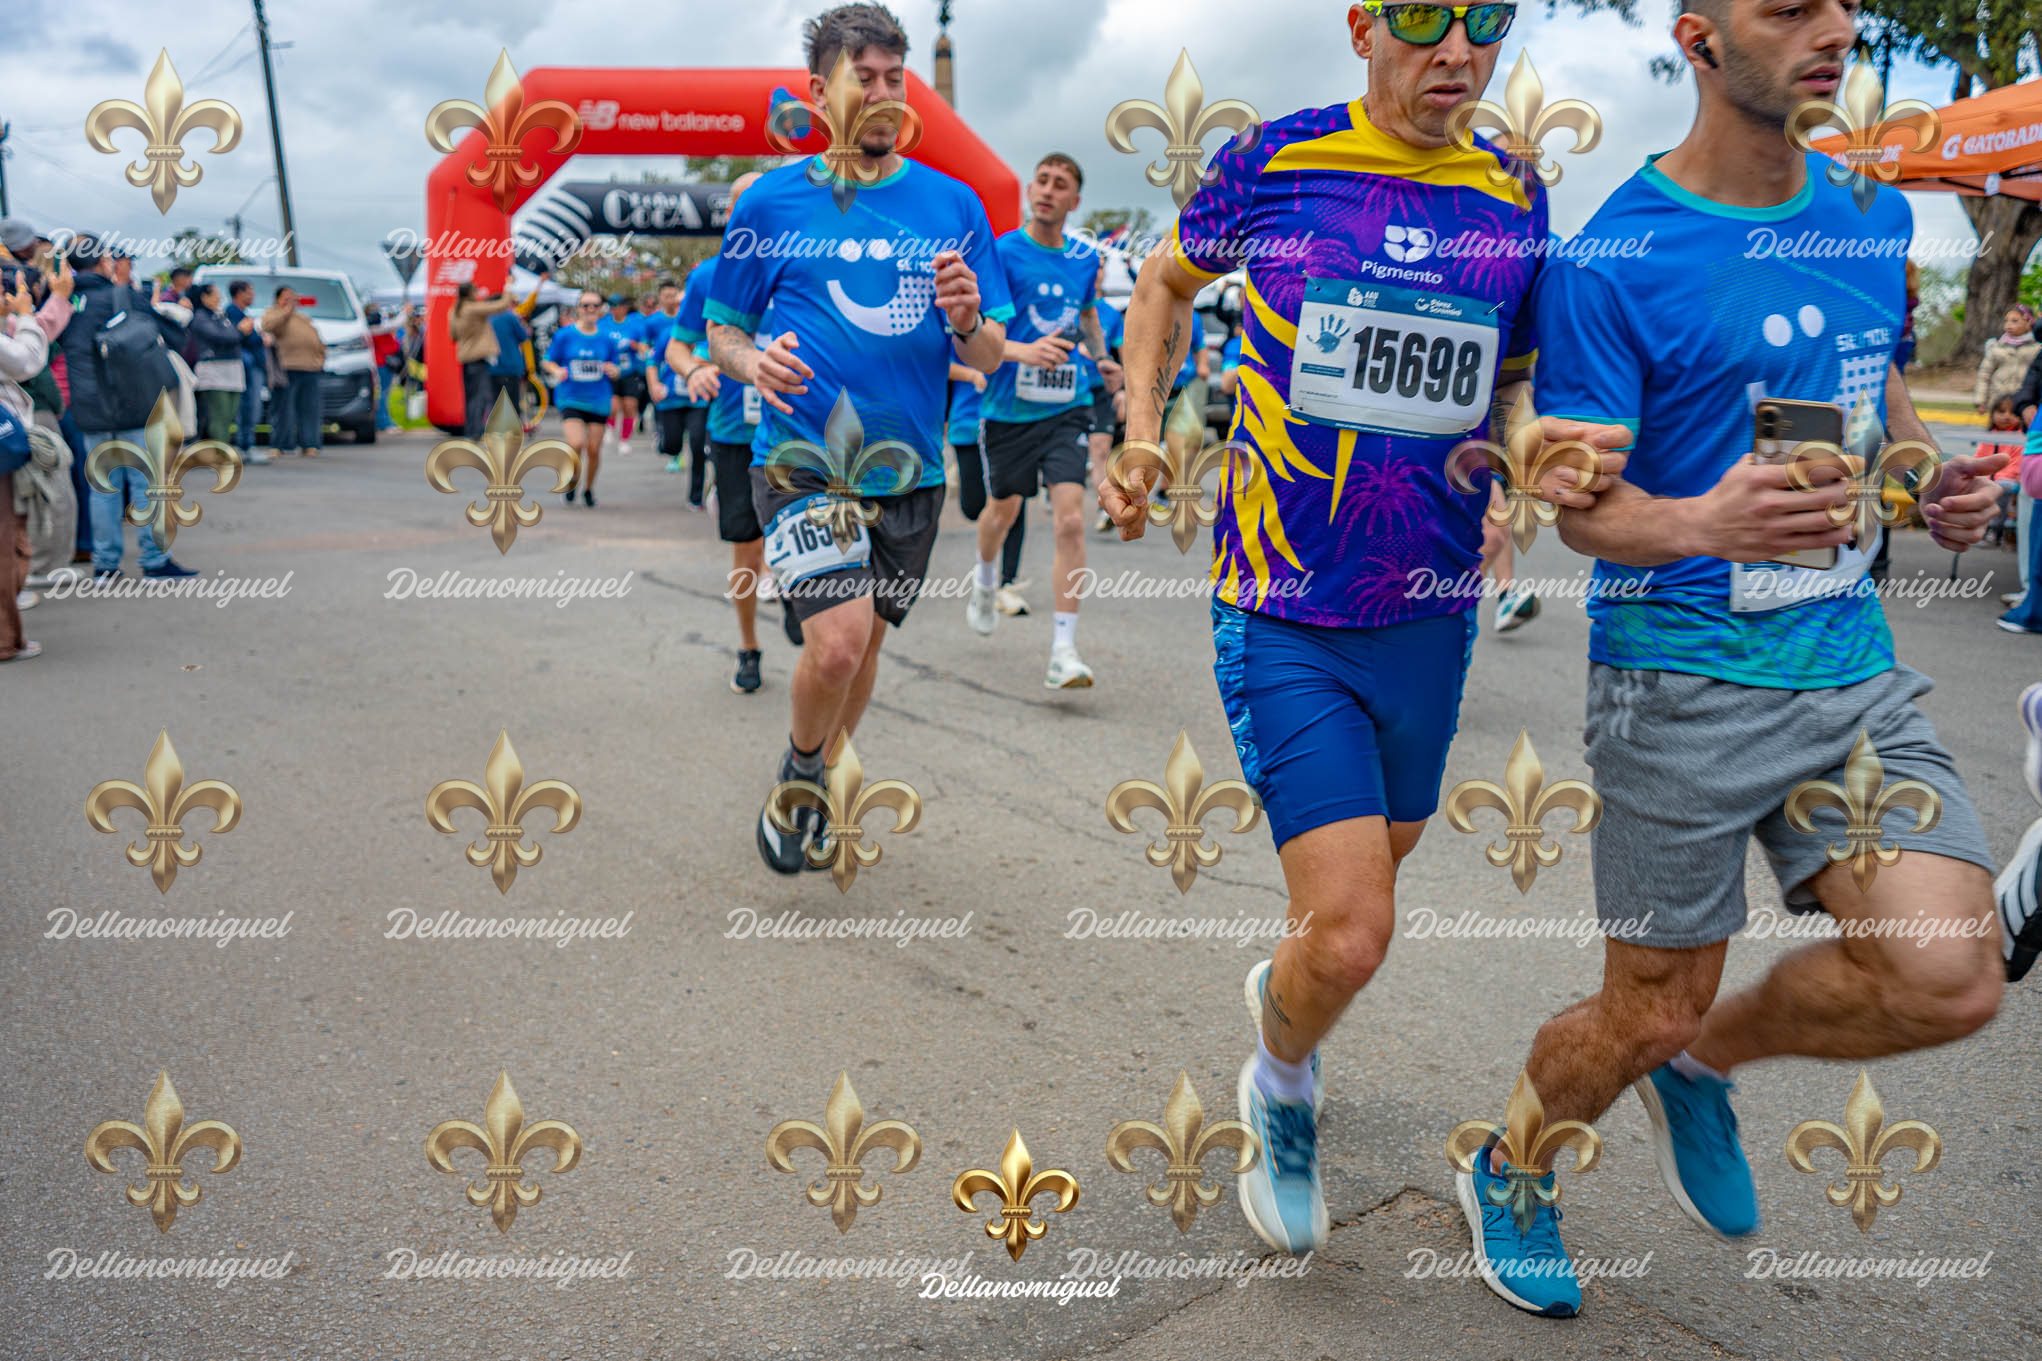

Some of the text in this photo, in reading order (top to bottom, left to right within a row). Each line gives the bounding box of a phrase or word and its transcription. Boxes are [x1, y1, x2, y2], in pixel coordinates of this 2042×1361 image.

[618, 112, 660, 131] new
[660, 109, 746, 132] balance
[1963, 122, 2042, 156] GATORAD
[1360, 260, 1443, 285] Pigmento
[1353, 325, 1482, 407] 15698
